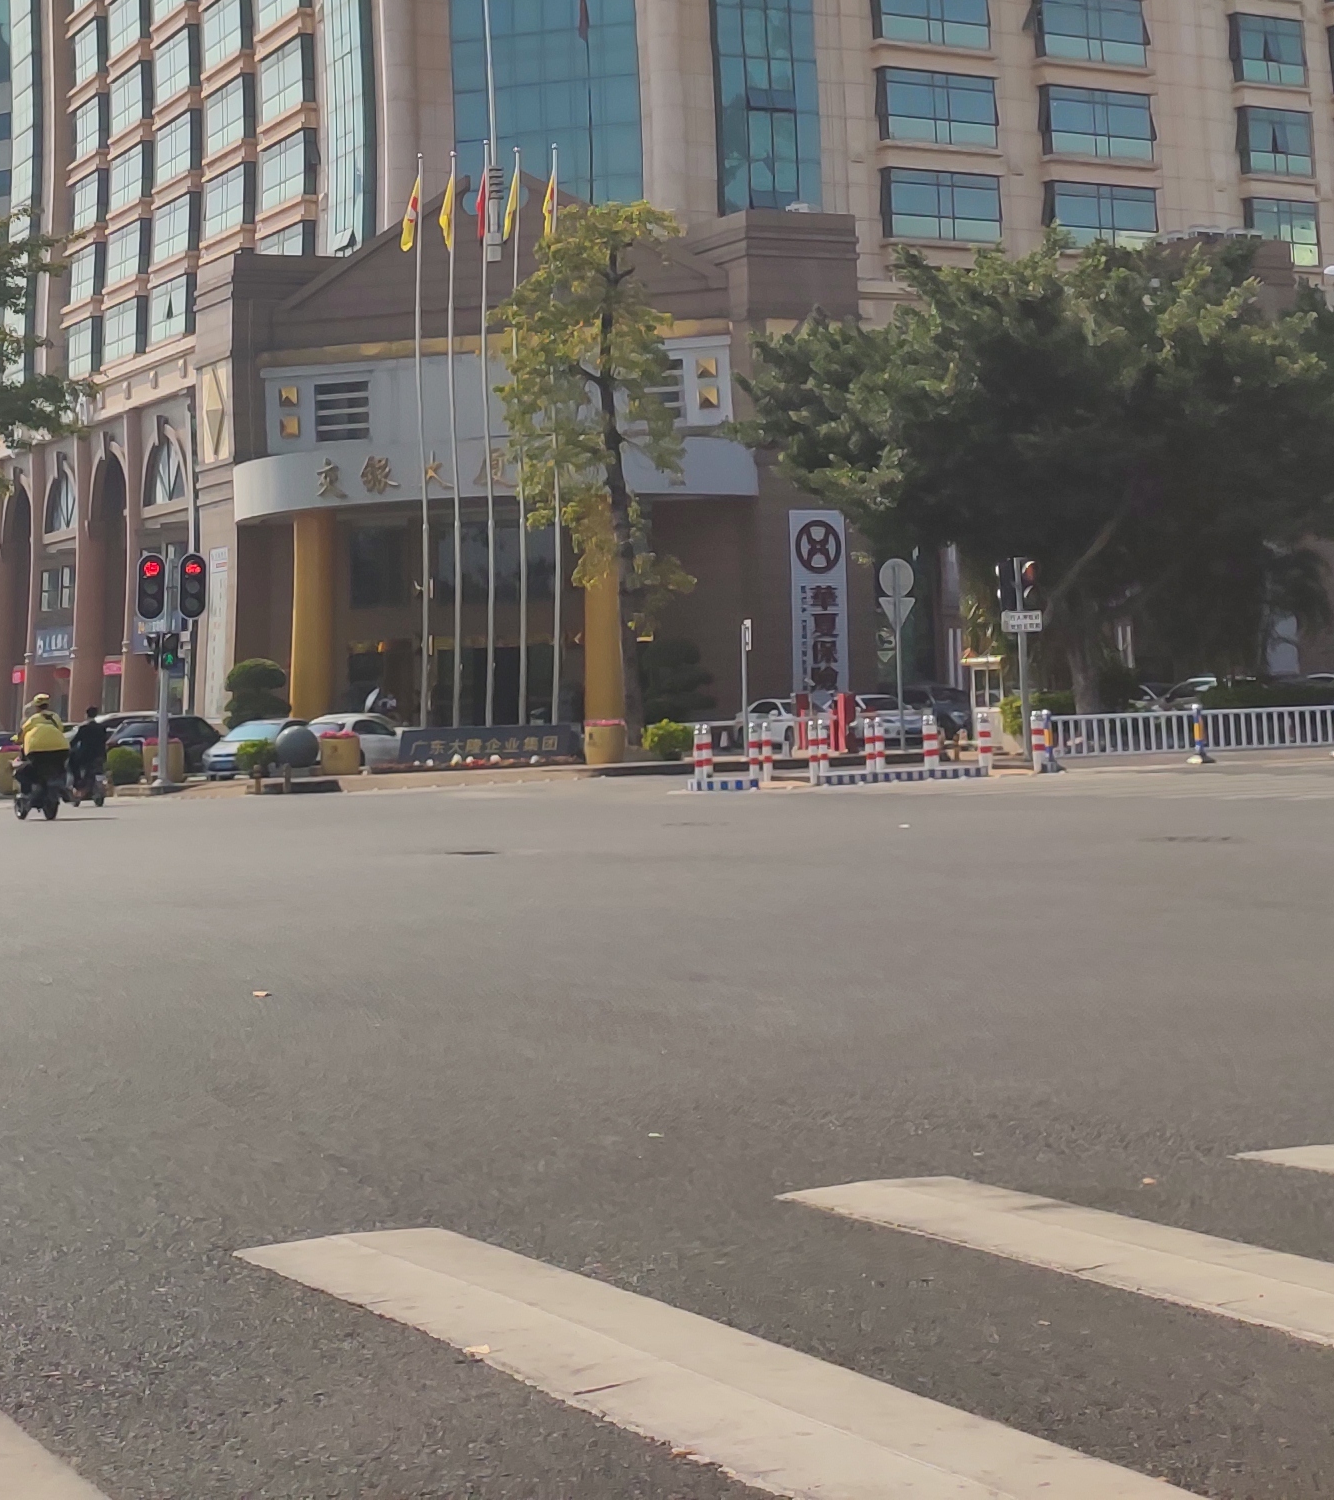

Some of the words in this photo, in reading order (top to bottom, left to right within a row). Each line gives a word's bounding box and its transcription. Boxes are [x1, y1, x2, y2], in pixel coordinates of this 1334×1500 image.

[410, 735, 558, 756] 广东大隆企业集团
